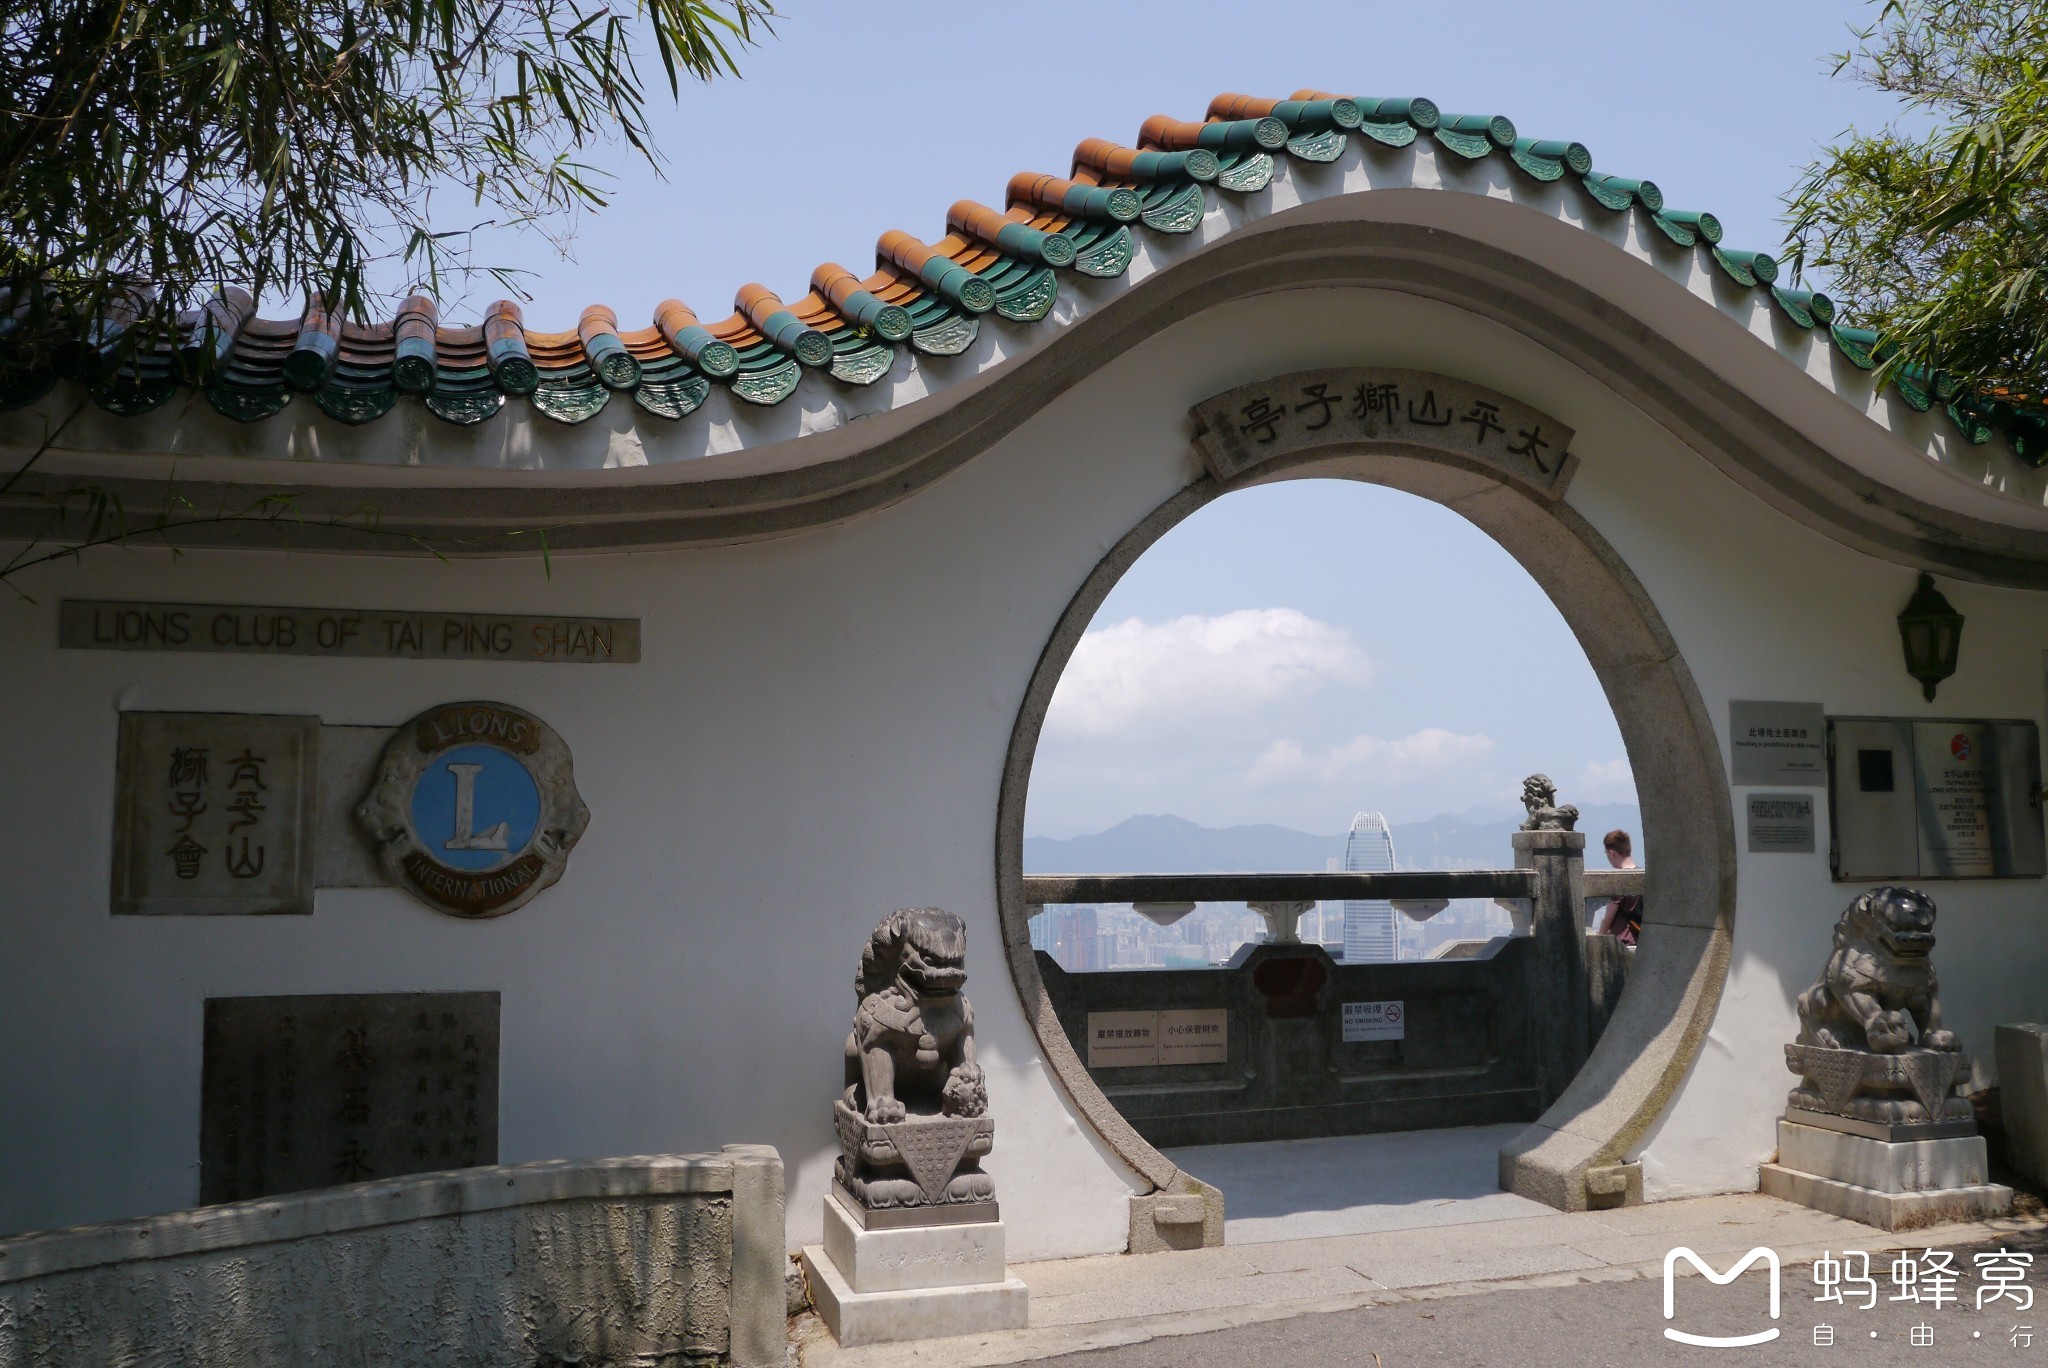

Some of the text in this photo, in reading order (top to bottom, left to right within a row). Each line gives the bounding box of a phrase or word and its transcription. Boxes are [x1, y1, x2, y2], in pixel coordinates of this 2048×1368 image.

[1239, 382, 1551, 475] 太平山獅子亭
[94, 609, 614, 657] LIONS CLUB OF TAI PING SHAN
[432, 709, 530, 745] LIONS
[1735, 740, 1758, 748] Smoking
[444, 762, 510, 850] L
[408, 857, 539, 900] INTERNATIONAL
[1168, 1025, 1219, 1035] 小心保管財物
